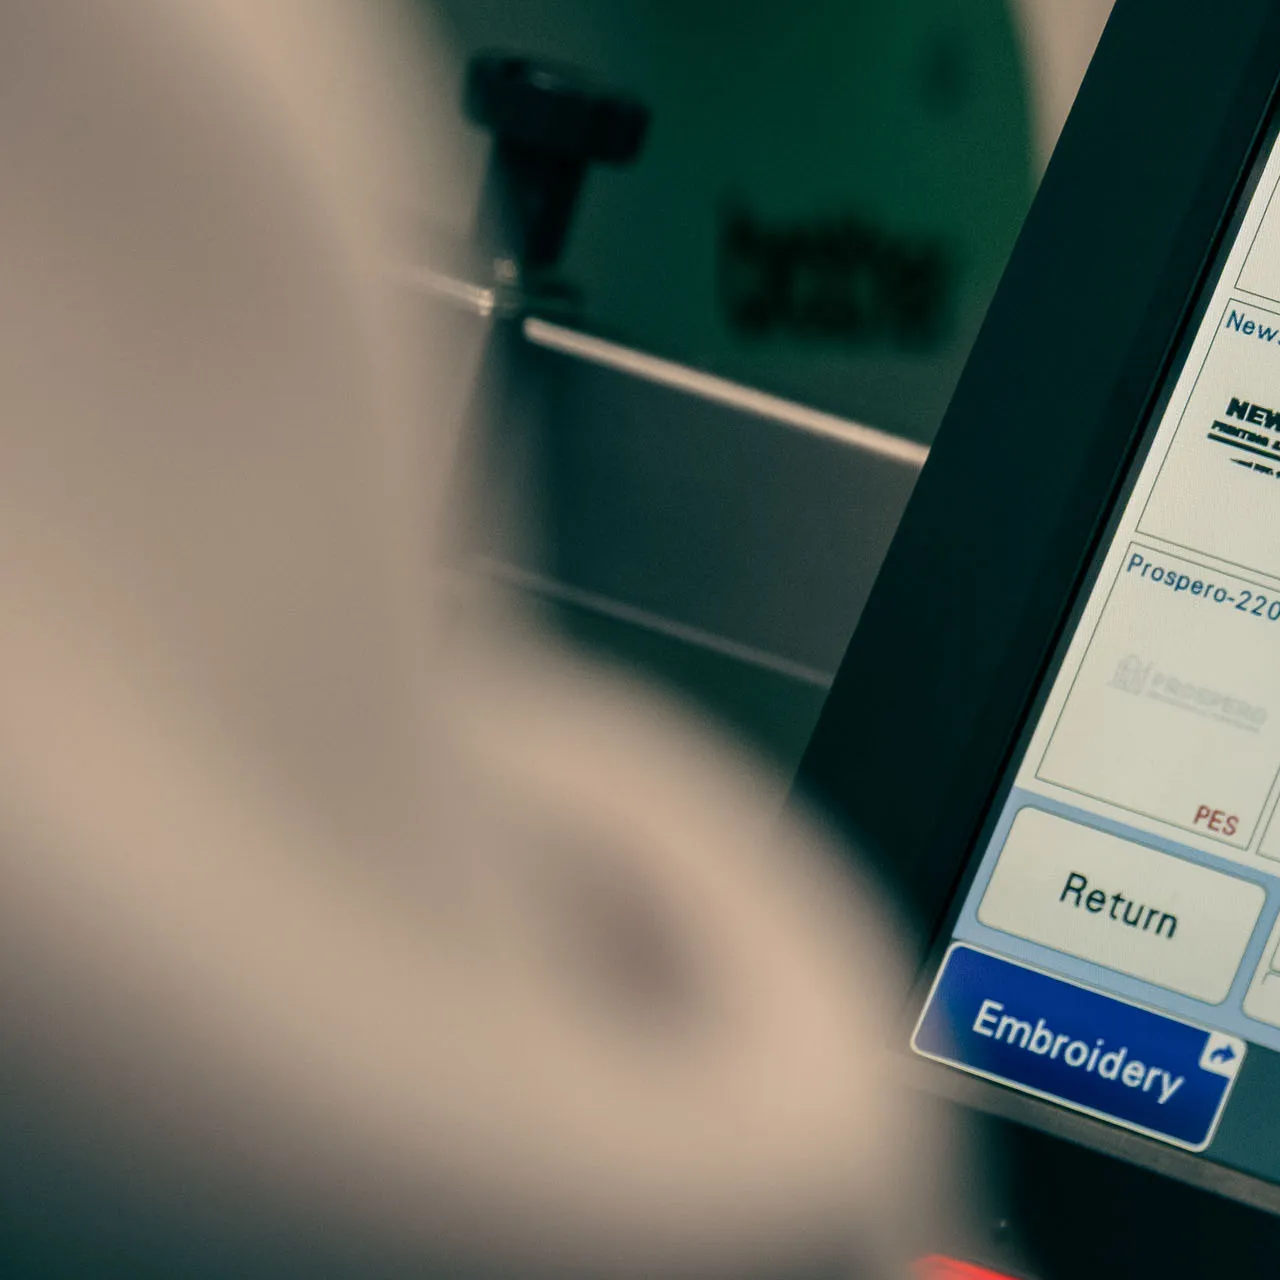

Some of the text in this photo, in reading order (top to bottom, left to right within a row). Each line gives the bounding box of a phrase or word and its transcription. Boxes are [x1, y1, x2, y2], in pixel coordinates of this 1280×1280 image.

[1193, 805, 1239, 836] PES
[1059, 872, 1178, 939] Return
[972, 999, 1186, 1104] Embroidery
